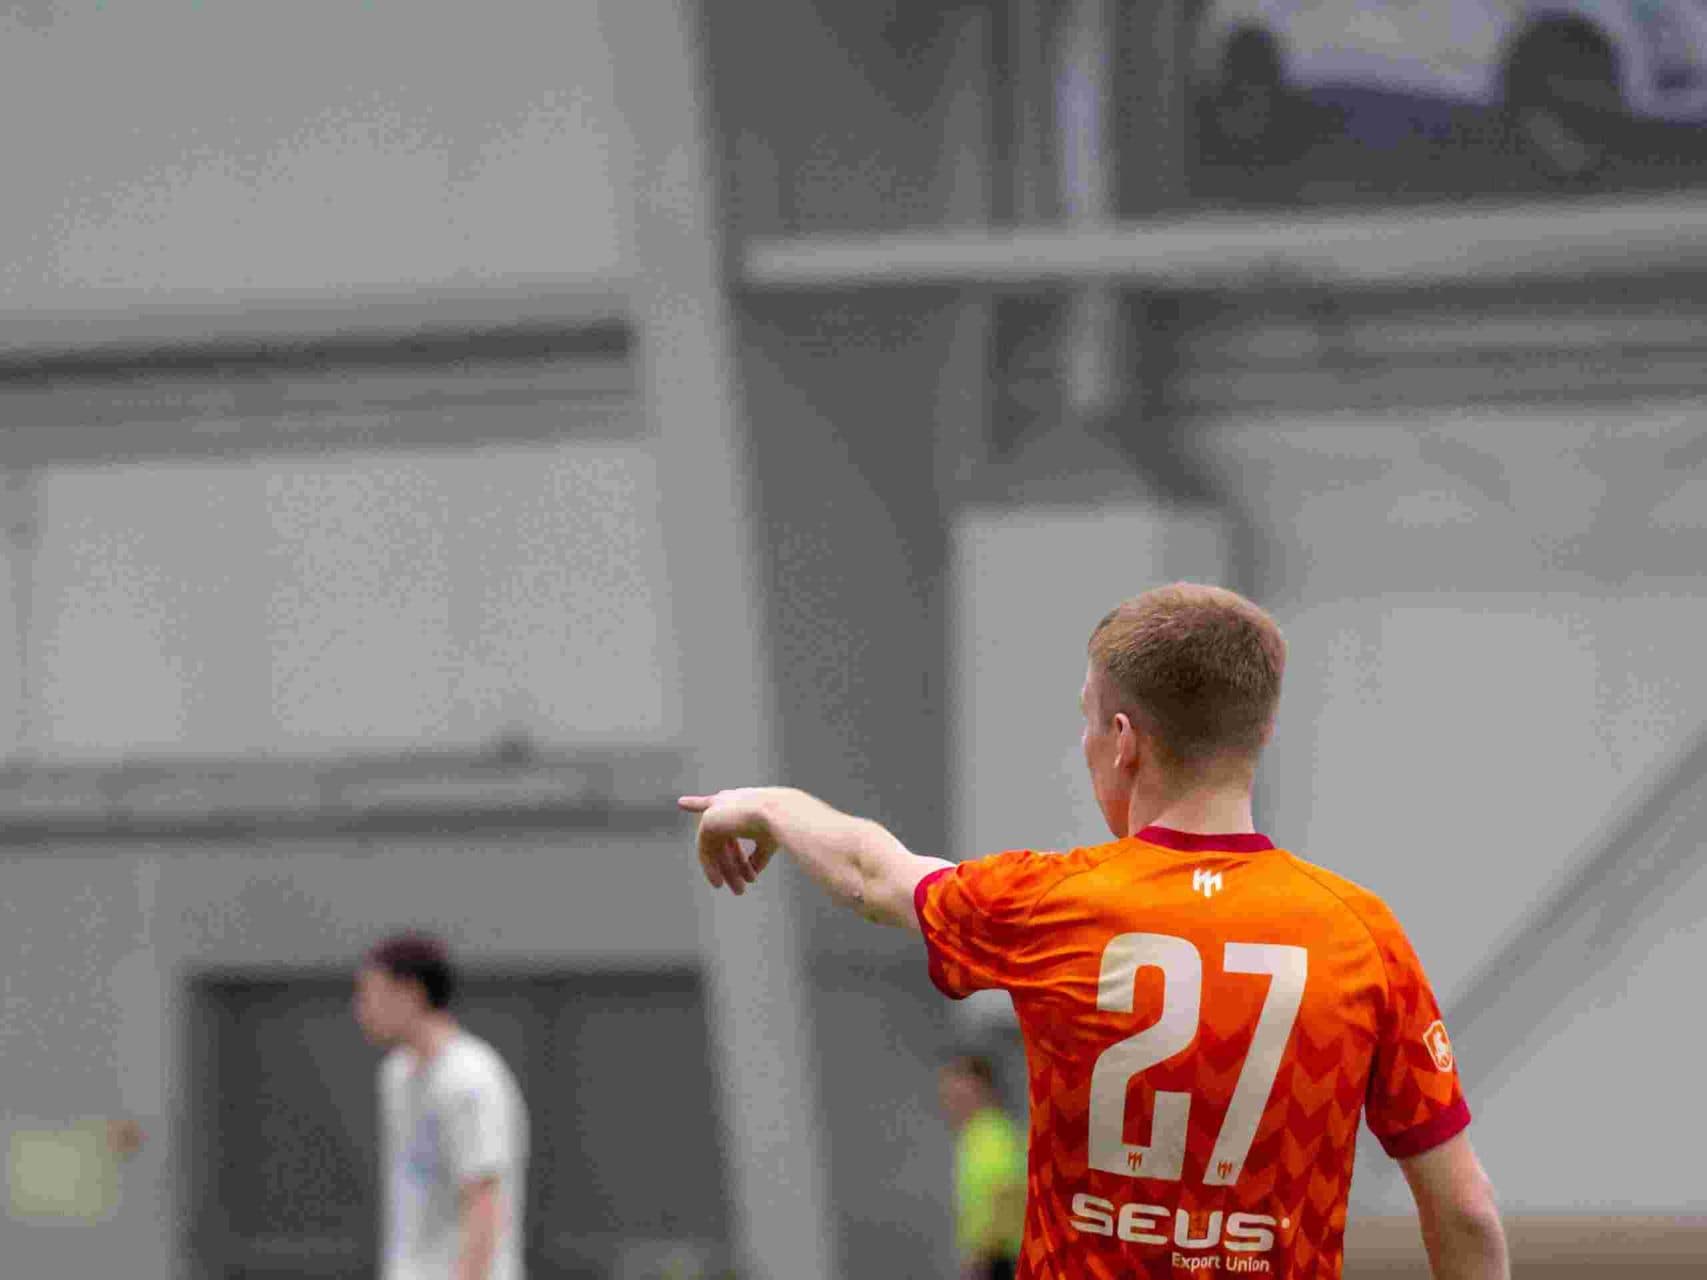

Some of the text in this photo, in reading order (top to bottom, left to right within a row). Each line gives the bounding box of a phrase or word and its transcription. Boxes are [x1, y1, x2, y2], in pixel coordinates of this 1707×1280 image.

[1089, 932, 1308, 1186] 27
[1070, 1193, 1278, 1252] SEUS
[1171, 1252, 1270, 1272] Export Union
